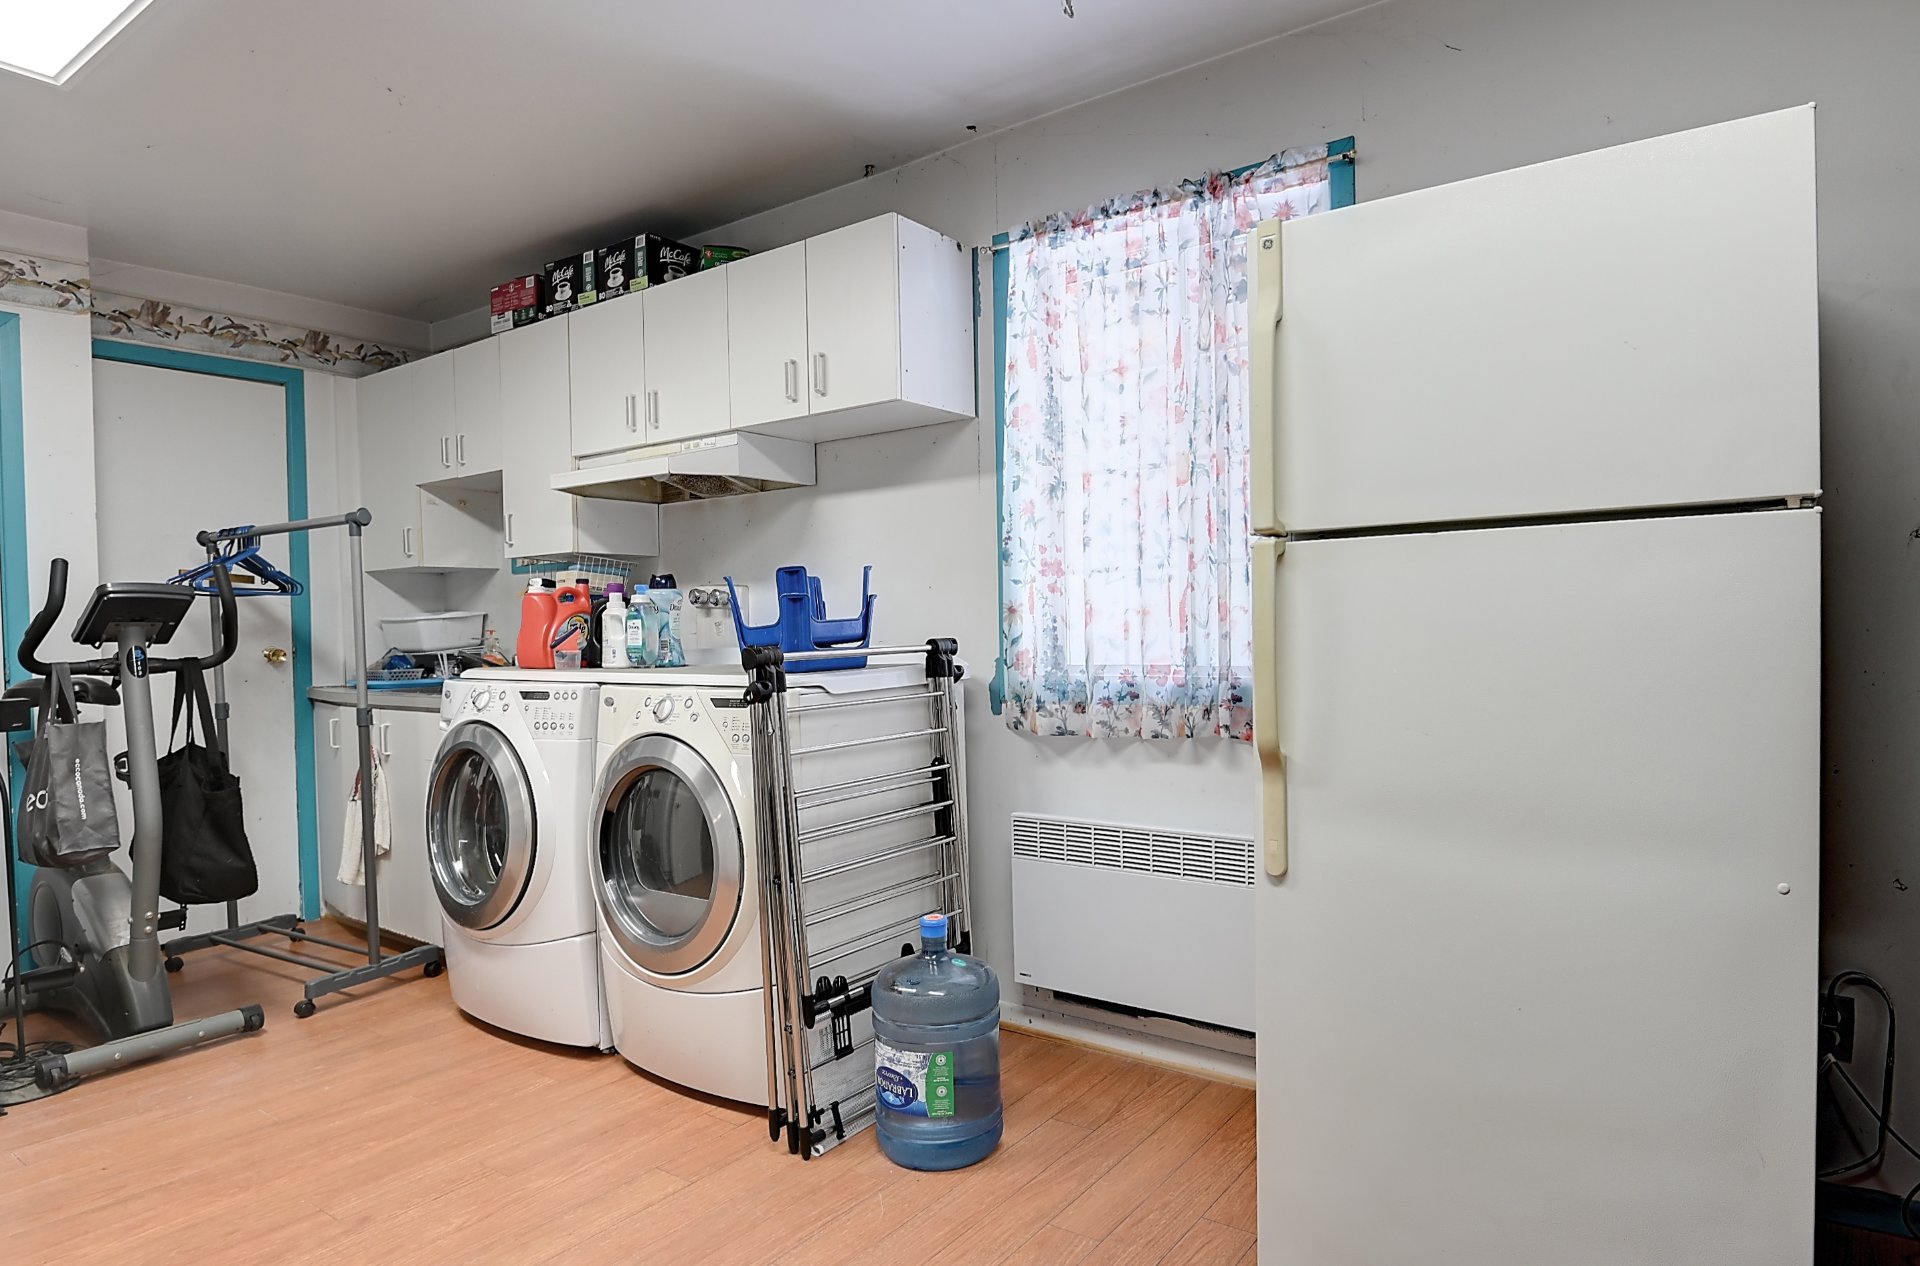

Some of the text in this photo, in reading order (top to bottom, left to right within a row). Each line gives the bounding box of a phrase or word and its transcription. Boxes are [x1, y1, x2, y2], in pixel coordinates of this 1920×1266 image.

[604, 249, 626, 270] McCafé
[659, 246, 693, 266] McCafé
[551, 264, 574, 284] McCafé
[75, 758, 87, 820] eccocanada.com
